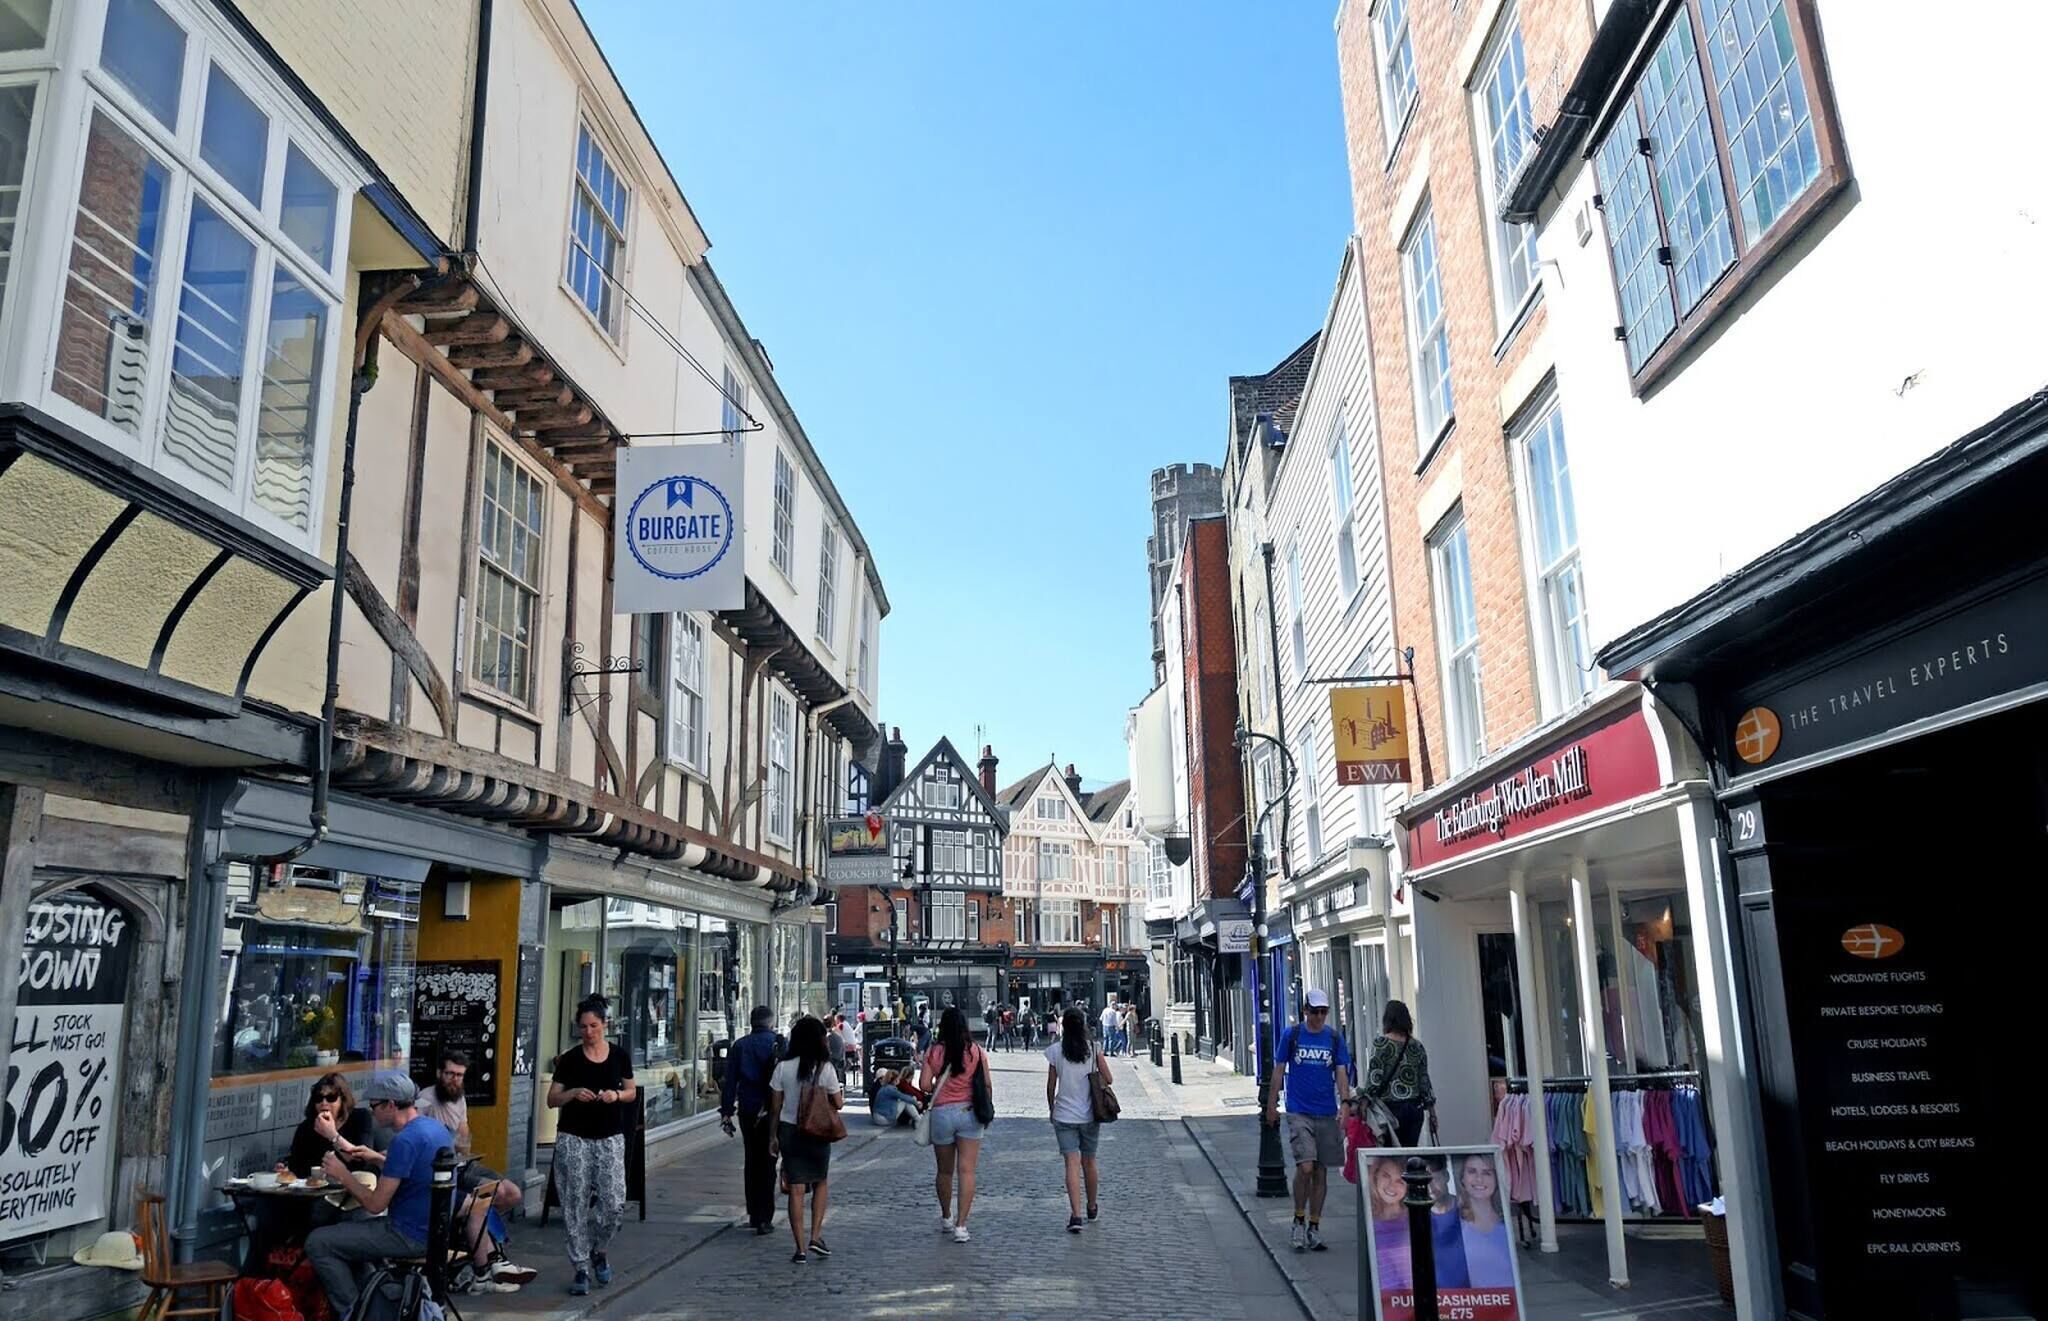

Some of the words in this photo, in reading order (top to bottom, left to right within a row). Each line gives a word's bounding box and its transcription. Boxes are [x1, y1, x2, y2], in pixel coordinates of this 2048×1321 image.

[639, 514, 721, 541] BURGATE
[647, 546, 679, 555] COFFEE
[684, 545, 711, 553] HOUSE
[1790, 706, 1819, 730] THE
[1829, 677, 1896, 715] TRAVEL
[1910, 633, 2008, 686] EXPERTS
[1346, 763, 1402, 781] EWM
[1434, 808, 1452, 842] The
[1451, 782, 1502, 833] Edinburgh
[1501, 768, 1550, 814] Woollen
[1552, 745, 1584, 797] Mill
[1738, 810, 1756, 841] 29
[829, 869, 891, 880] COOKSHOP
[830, 955, 838, 964] 12
[1830, 972, 1888, 983] WORLDWIDE
[1890, 971, 1926, 982] FLIGHTS
[1821, 1006, 1857, 1016] PRIVATE
[1858, 1005, 1899, 1015] BESPOKE
[1900, 1004, 1943, 1014] TOURING
[53, 1014, 93, 1031] STOCK
[11, 1015, 49, 1053] LL
[51, 1034, 83, 1050] MUST
[85, 1032, 106, 1049] GO!
[1847, 1039, 1879, 1049] CRUISE
[1881, 1037, 1927, 1048] HOLIDAYS
[1298, 1049, 1331, 1060] DAVE
[1851, 1072, 1896, 1082] BUSINESS
[1897, 1071, 1931, 1080] TRAVEL
[1831, 1106, 1869, 1116] HOTELS,
[1871, 1104, 1909, 1115] LODGES
[1911, 1104, 1918, 1114] &
[1920, 1103, 1960, 1113] RESORTS
[59, 1125, 100, 1155] OFF
[1825, 1141, 1857, 1151] BEACH
[1860, 1139, 1906, 1149] HOLIDAYS
[1908, 1139, 1916, 1149] &
[1918, 1138, 1938, 1148] CITY
[1939, 1138, 1975, 1147] BREAKS
[0, 1161, 81, 1194] SOLUTELY
[1880, 1174, 1895, 1183] FLY
[1897, 1173, 1930, 1182] DRIVES
[0, 1187, 77, 1221] ERYTHING
[1872, 1207, 1946, 1218] HONEYMOONS
[1867, 1244, 1887, 1253] EPIC
[1889, 1243, 1909, 1252] RAIL
[1911, 1241, 1961, 1251] JOURNEYS
[1391, 1296, 1414, 1307] PU
[1450, 1307, 1474, 1319] £75
